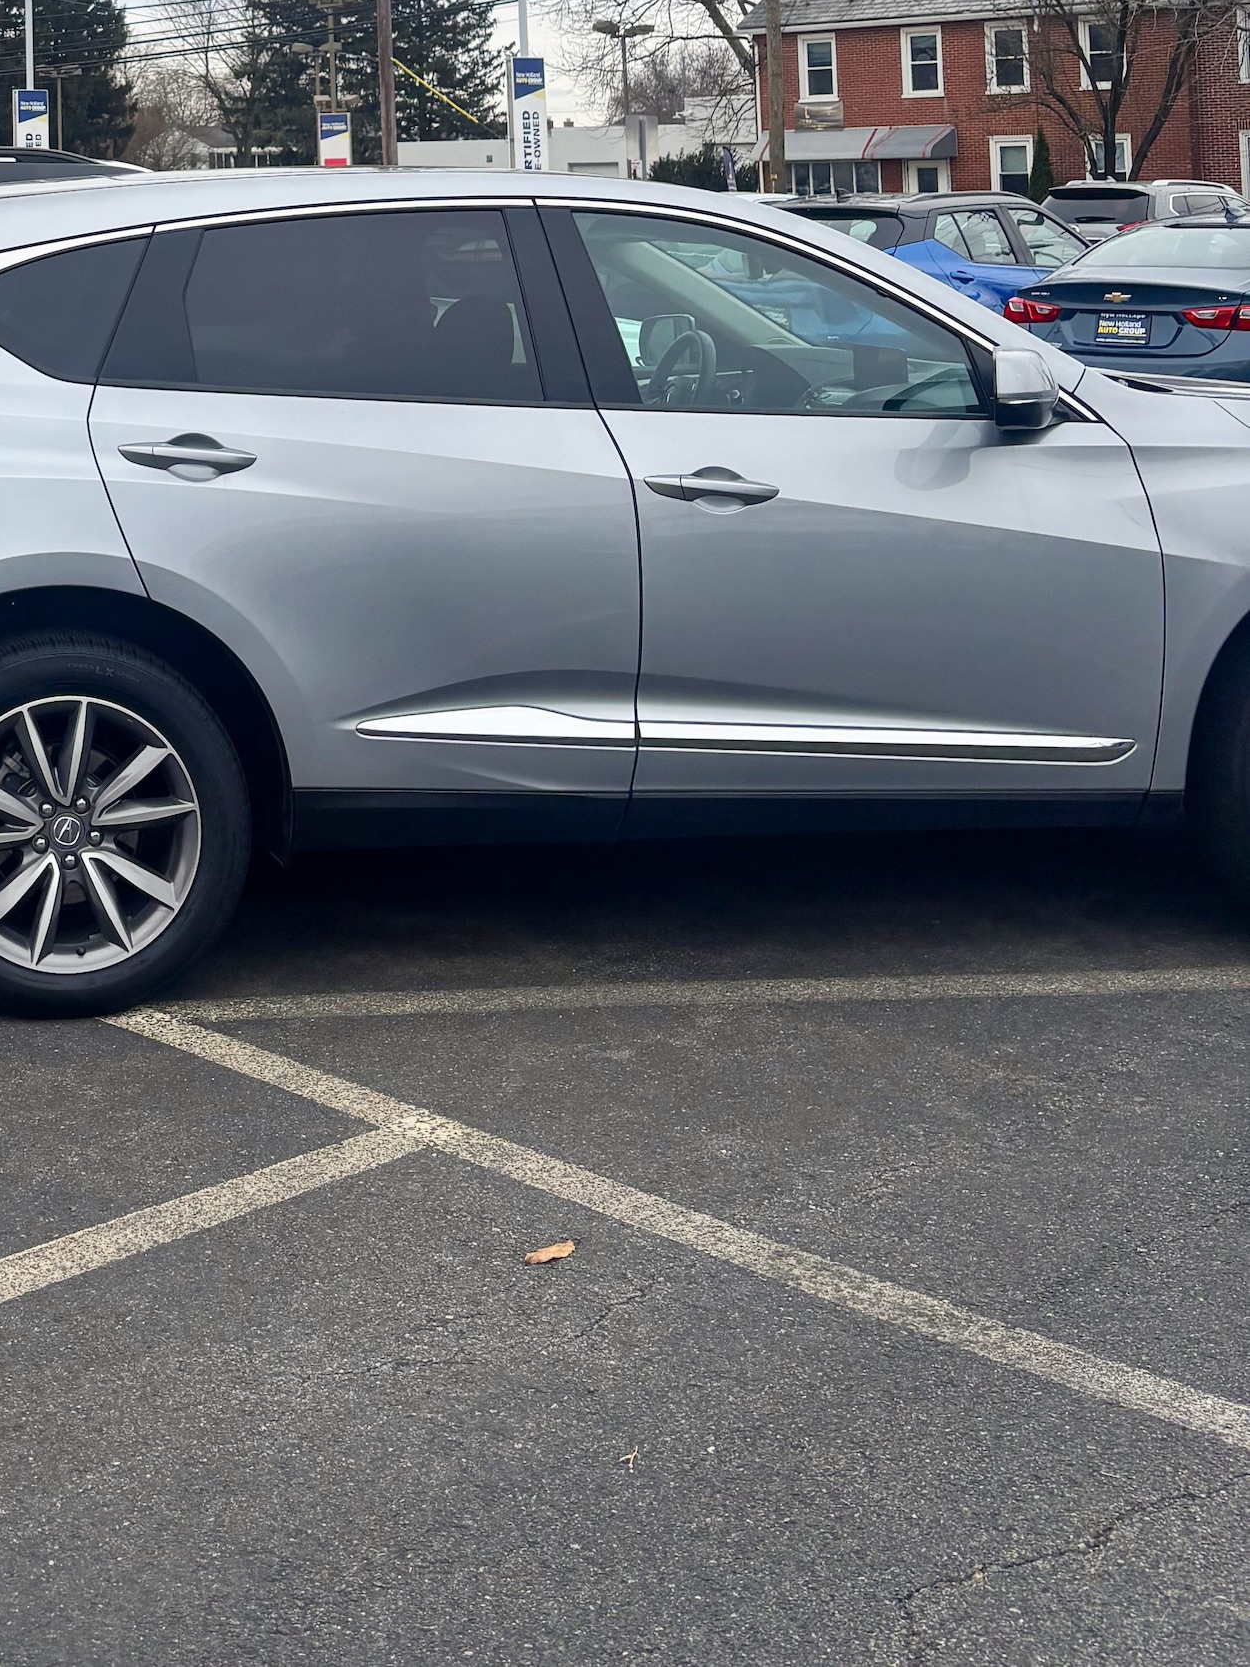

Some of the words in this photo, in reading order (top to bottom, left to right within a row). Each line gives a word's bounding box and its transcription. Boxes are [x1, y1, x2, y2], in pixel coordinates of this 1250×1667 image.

[522, 110, 533, 170] RTIFIED
[532, 111, 542, 170] E-OWNED
[1116, 320, 1141, 328] Holland
[95, 665, 115, 678] LX
